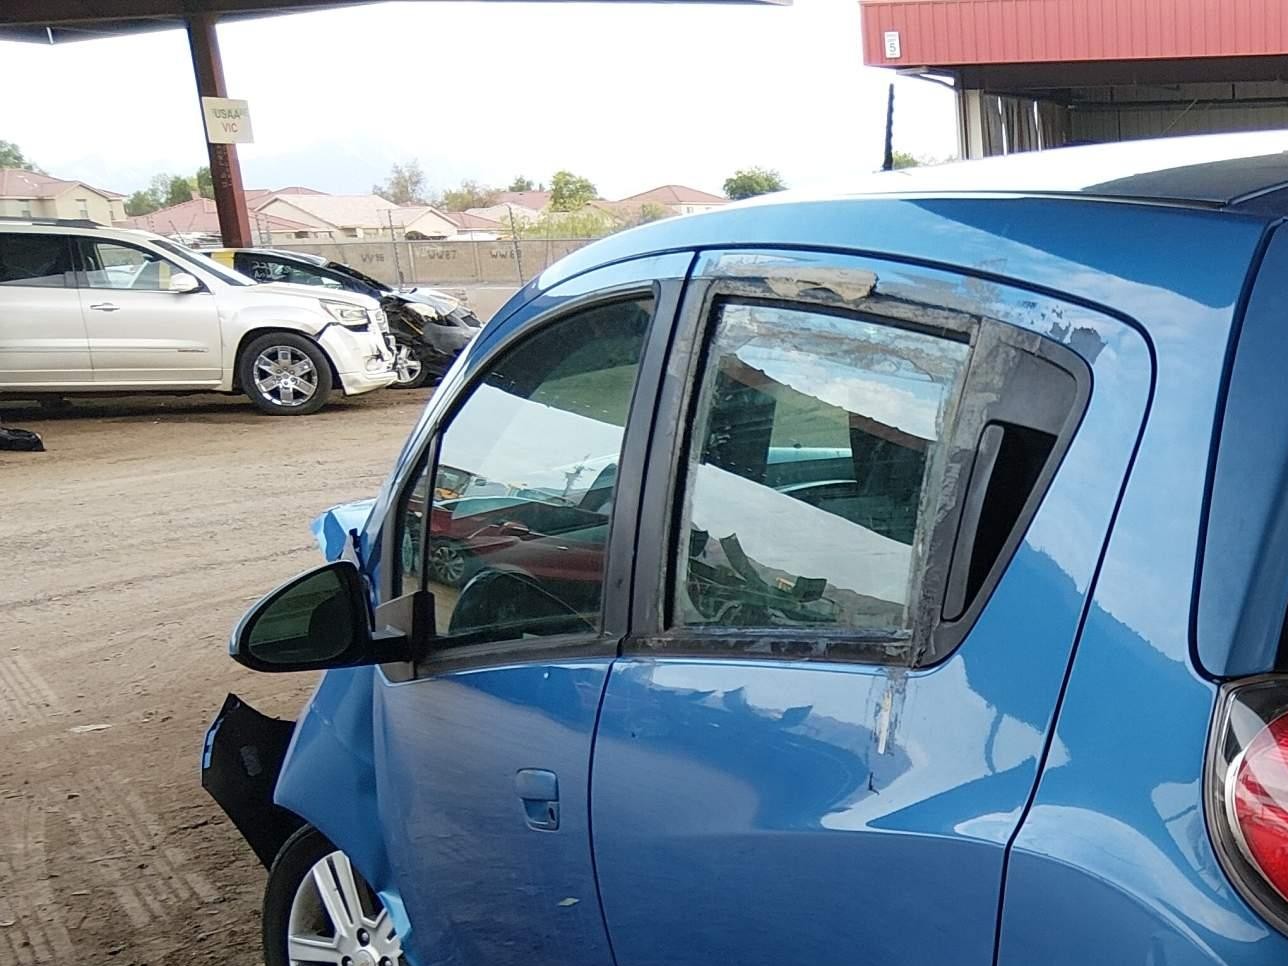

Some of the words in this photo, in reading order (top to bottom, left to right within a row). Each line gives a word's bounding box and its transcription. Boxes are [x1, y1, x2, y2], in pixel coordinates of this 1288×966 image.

[889, 43, 897, 53] 5
[214, 108, 241, 119] USAA
[222, 121, 239, 133] VIC
